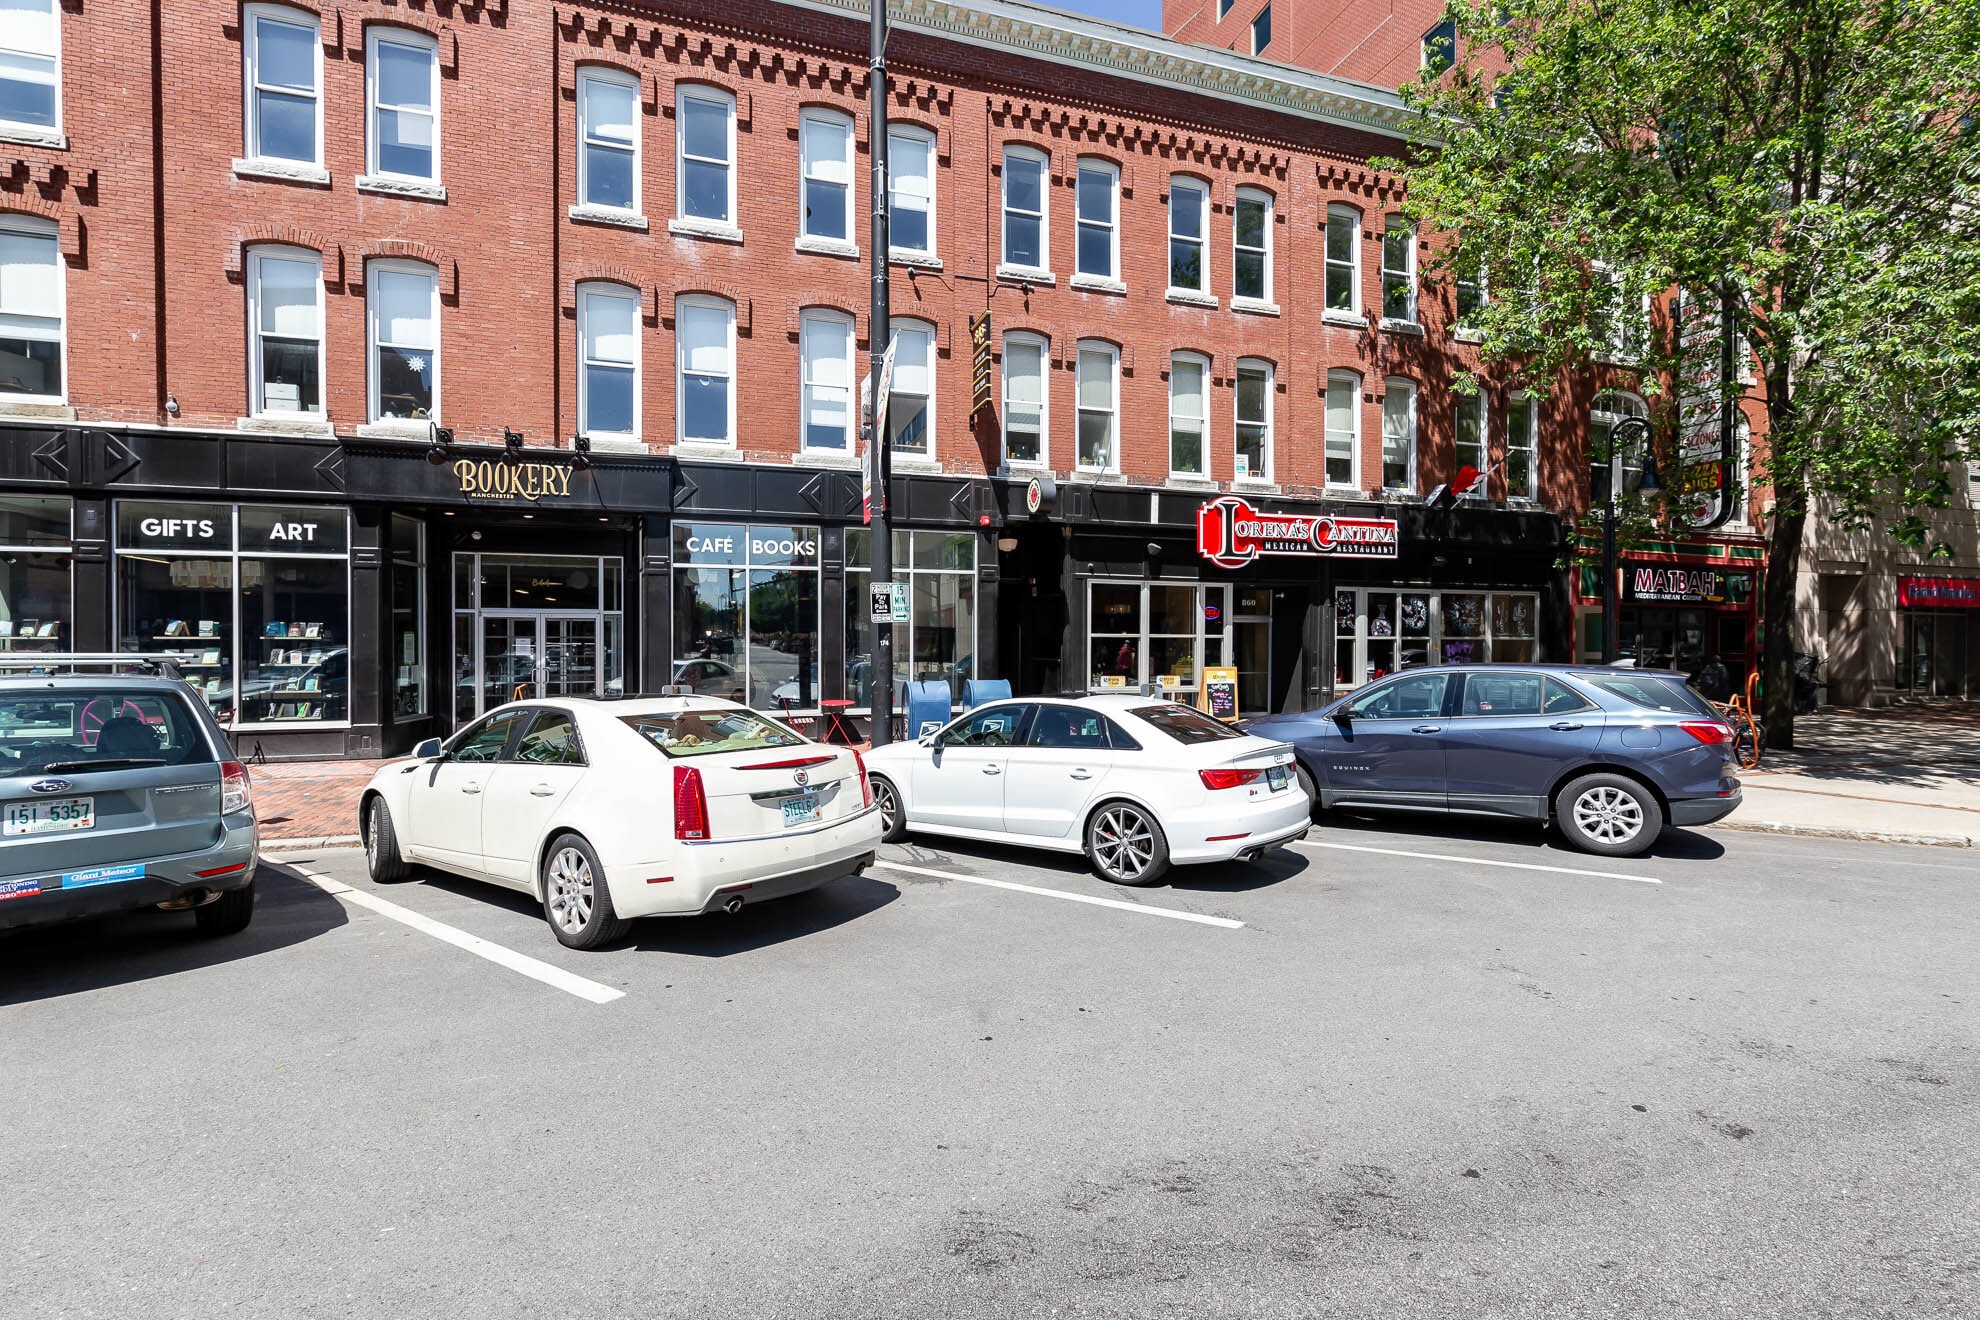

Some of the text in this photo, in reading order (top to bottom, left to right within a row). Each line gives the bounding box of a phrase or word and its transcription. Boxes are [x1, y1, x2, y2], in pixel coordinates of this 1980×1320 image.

[453, 459, 573, 500] BOOKERY
[140, 518, 214, 538] GIFTS
[269, 522, 317, 541] ART
[1215, 501, 1396, 559] LORENA'S CANTINA
[686, 535, 733, 553] CAFÉ
[752, 540, 816, 555] BOOKS
[1265, 541, 1394, 554] MEXICAN RESTAURANT
[896, 586, 904, 595] 15
[1634, 568, 1715, 595] MATBAH
[1635, 592, 1680, 601] MEDITERRANEAN
[11, 803, 90, 826] 151 5357
[71, 872, 99, 882] Giant
[101, 867, 137, 877] Meteor
